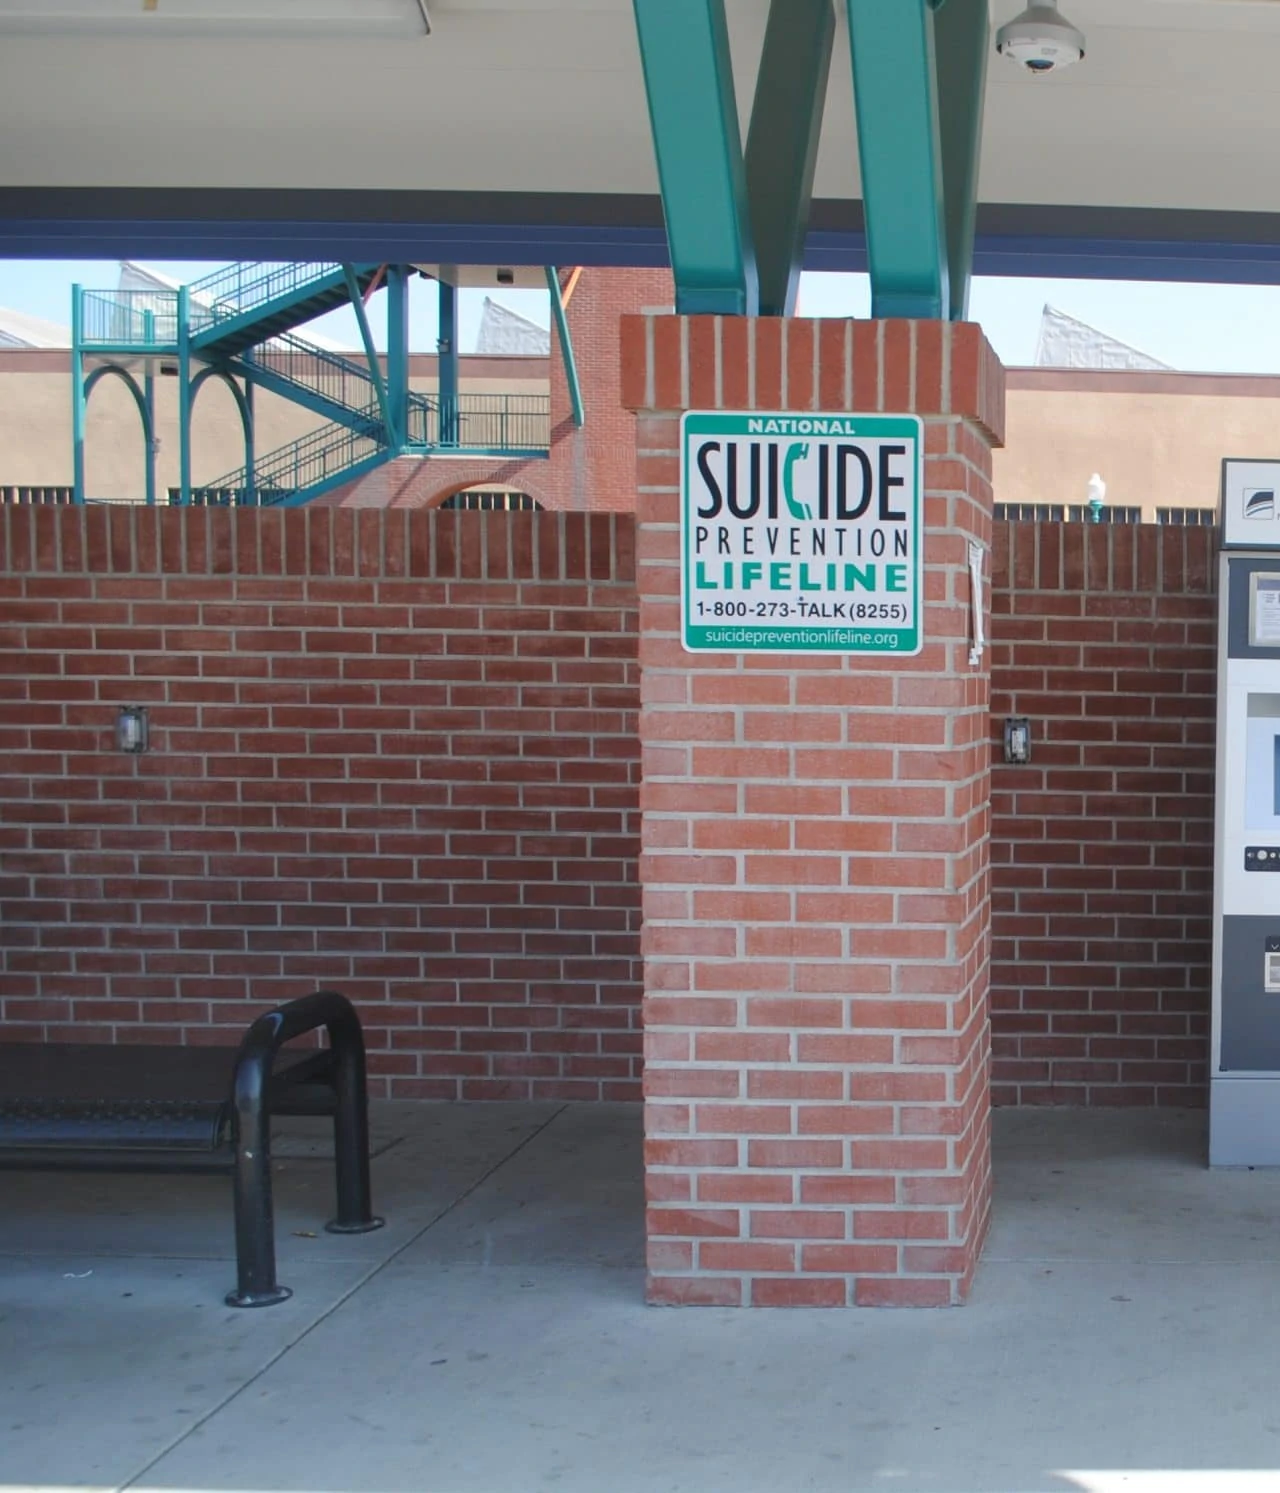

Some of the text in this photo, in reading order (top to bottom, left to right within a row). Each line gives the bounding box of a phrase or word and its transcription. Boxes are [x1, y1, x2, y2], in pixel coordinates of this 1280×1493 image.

[748, 419, 855, 434] NATIONAL
[697, 441, 906, 521] SUICIDE
[696, 526, 907, 557] PREVENTION
[696, 561, 907, 592] LIFELINE
[697, 601, 908, 622] 1-800-273-TALK (8255)
[705, 629, 898, 648] suicidepreventionlifeline.org
